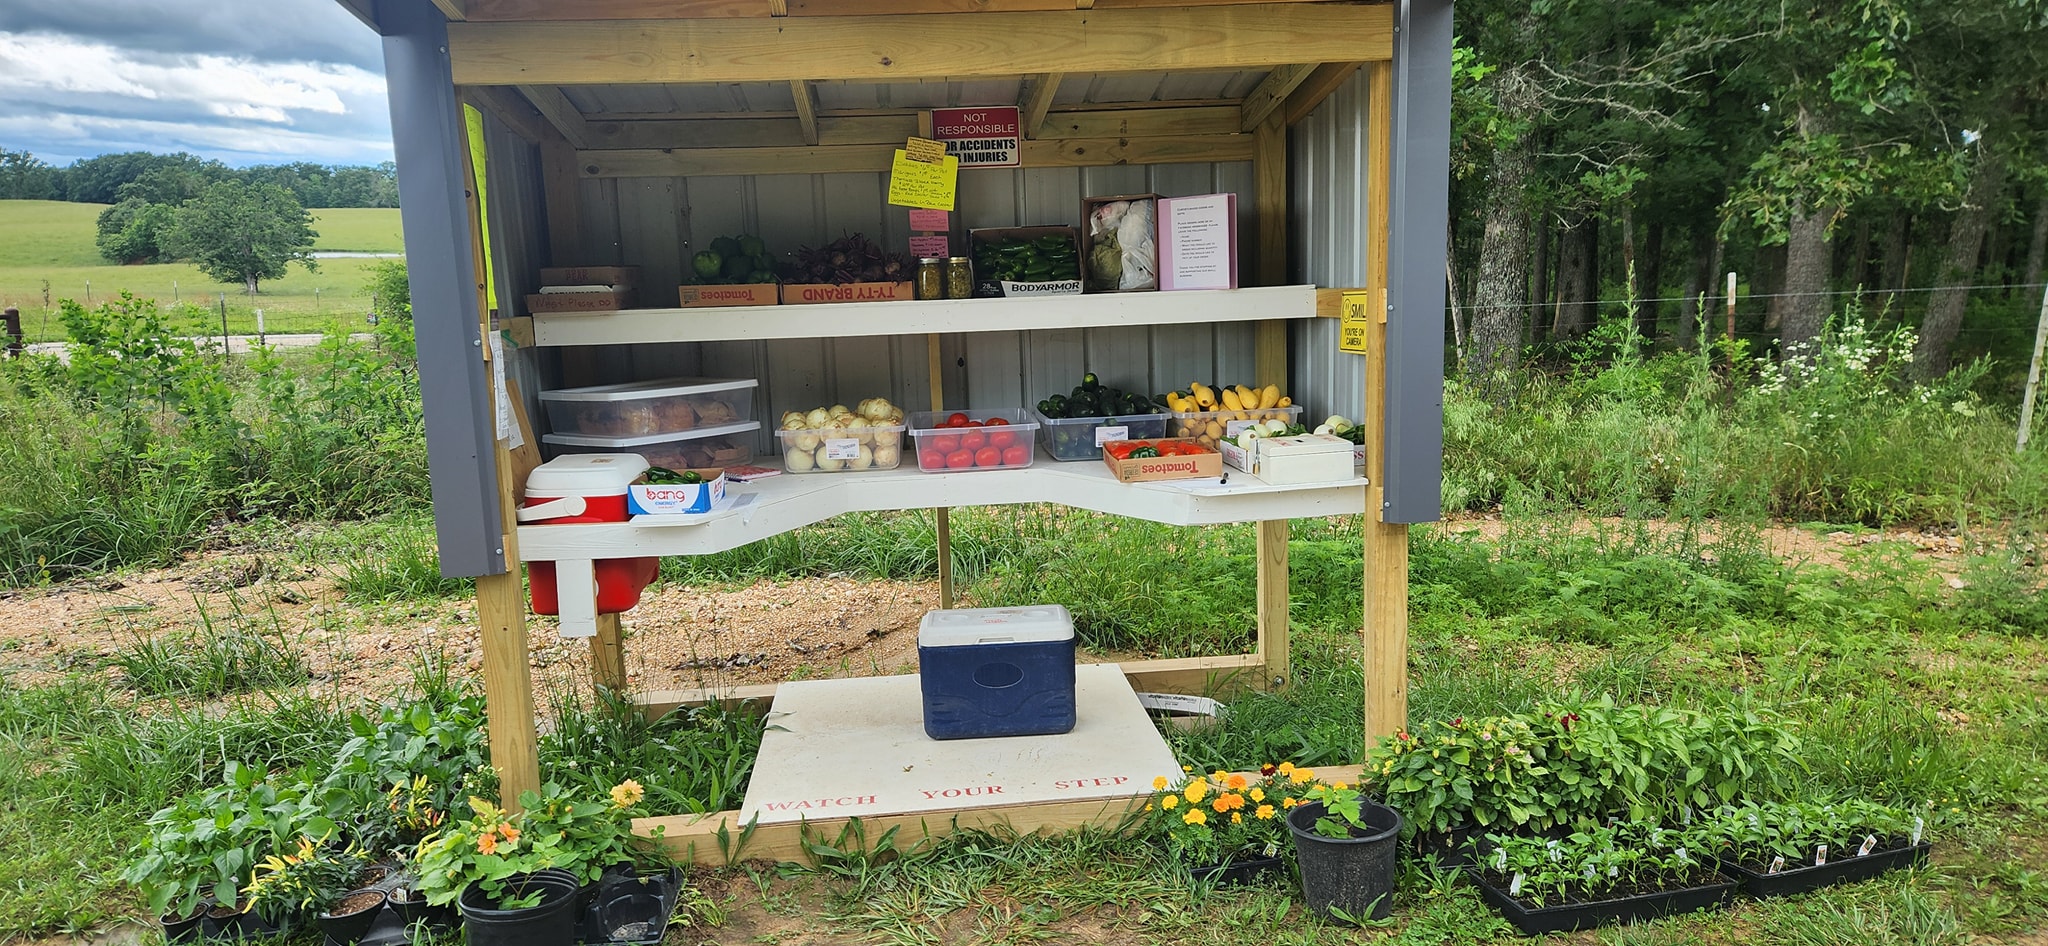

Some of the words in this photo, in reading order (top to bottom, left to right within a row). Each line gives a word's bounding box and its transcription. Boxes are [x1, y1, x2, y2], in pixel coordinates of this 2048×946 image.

[963, 113, 987, 122] NOT
[937, 124, 1015, 135] RESPONSIBLE
[945, 140, 957, 152] OR
[960, 139, 1015, 151] ACCIDENTS
[964, 151, 1008, 162] INJURIES
[857, 286, 895, 299] TY-TY
[1011, 282, 1080, 292] BODYARMOR
[701, 289, 755, 301] Tomatoes
[803, 287, 853, 300] BRAND
[1351, 303, 1366, 318] SMIL
[1345, 327, 1358, 336] YOU'RE
[1359, 327, 1365, 336] ON
[1346, 337, 1362, 346] CAMERA
[1142, 460, 1199, 474] Tomatoes
[646, 487, 685, 502] bang
[765, 794, 877, 812] WATCH
[922, 785, 1006, 800] YOUR
[1055, 775, 1129, 791] STEP
